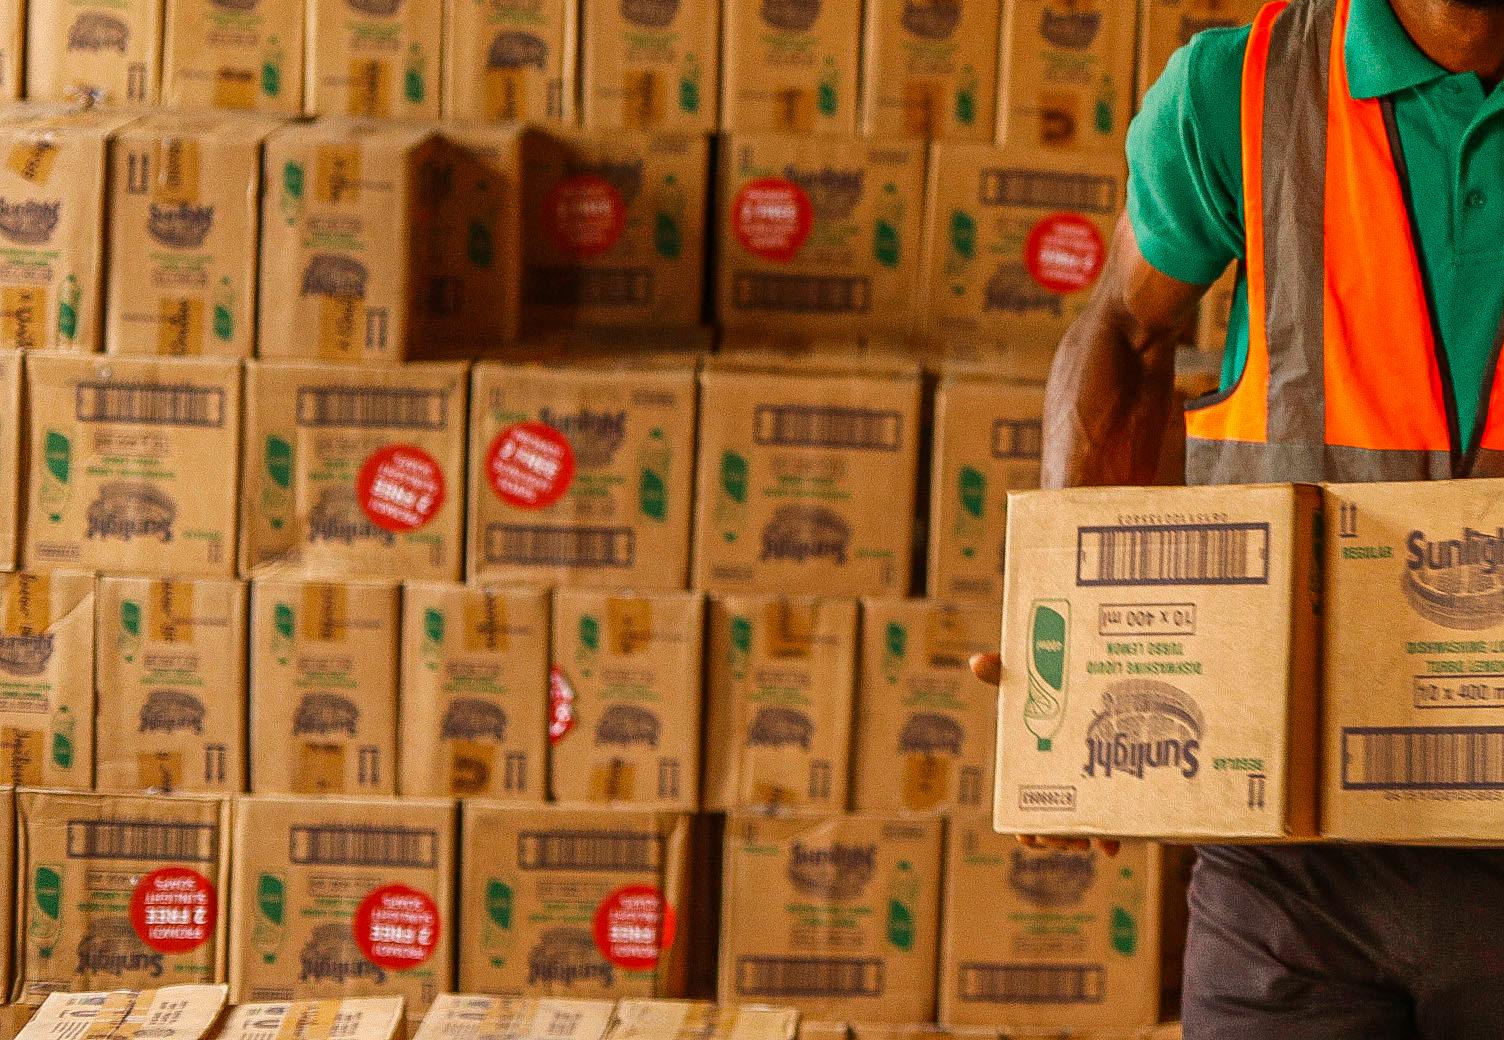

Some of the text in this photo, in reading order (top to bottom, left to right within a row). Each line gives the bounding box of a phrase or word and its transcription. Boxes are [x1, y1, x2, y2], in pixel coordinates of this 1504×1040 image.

[87, 516, 172, 543] Sunlight
[1103, 610, 1192, 627] 10 x 400 ml
[1106, 642, 1184, 655] TURBO LEMON
[1087, 661, 1203, 674] DISHWASHING LIQUID
[1417, 684, 1440, 700] 10
[1458, 684, 1488, 700] 400
[1084, 737, 1200, 779] Sunlight
[1213, 757, 1264, 770] REGULAR
[145, 906, 207, 925] 2 FREE
[370, 924, 432, 945] 2 FREE
[609, 925, 656, 943] FREE
[76, 949, 163, 977] Sunlight
[300, 958, 386, 986] Sunlight
